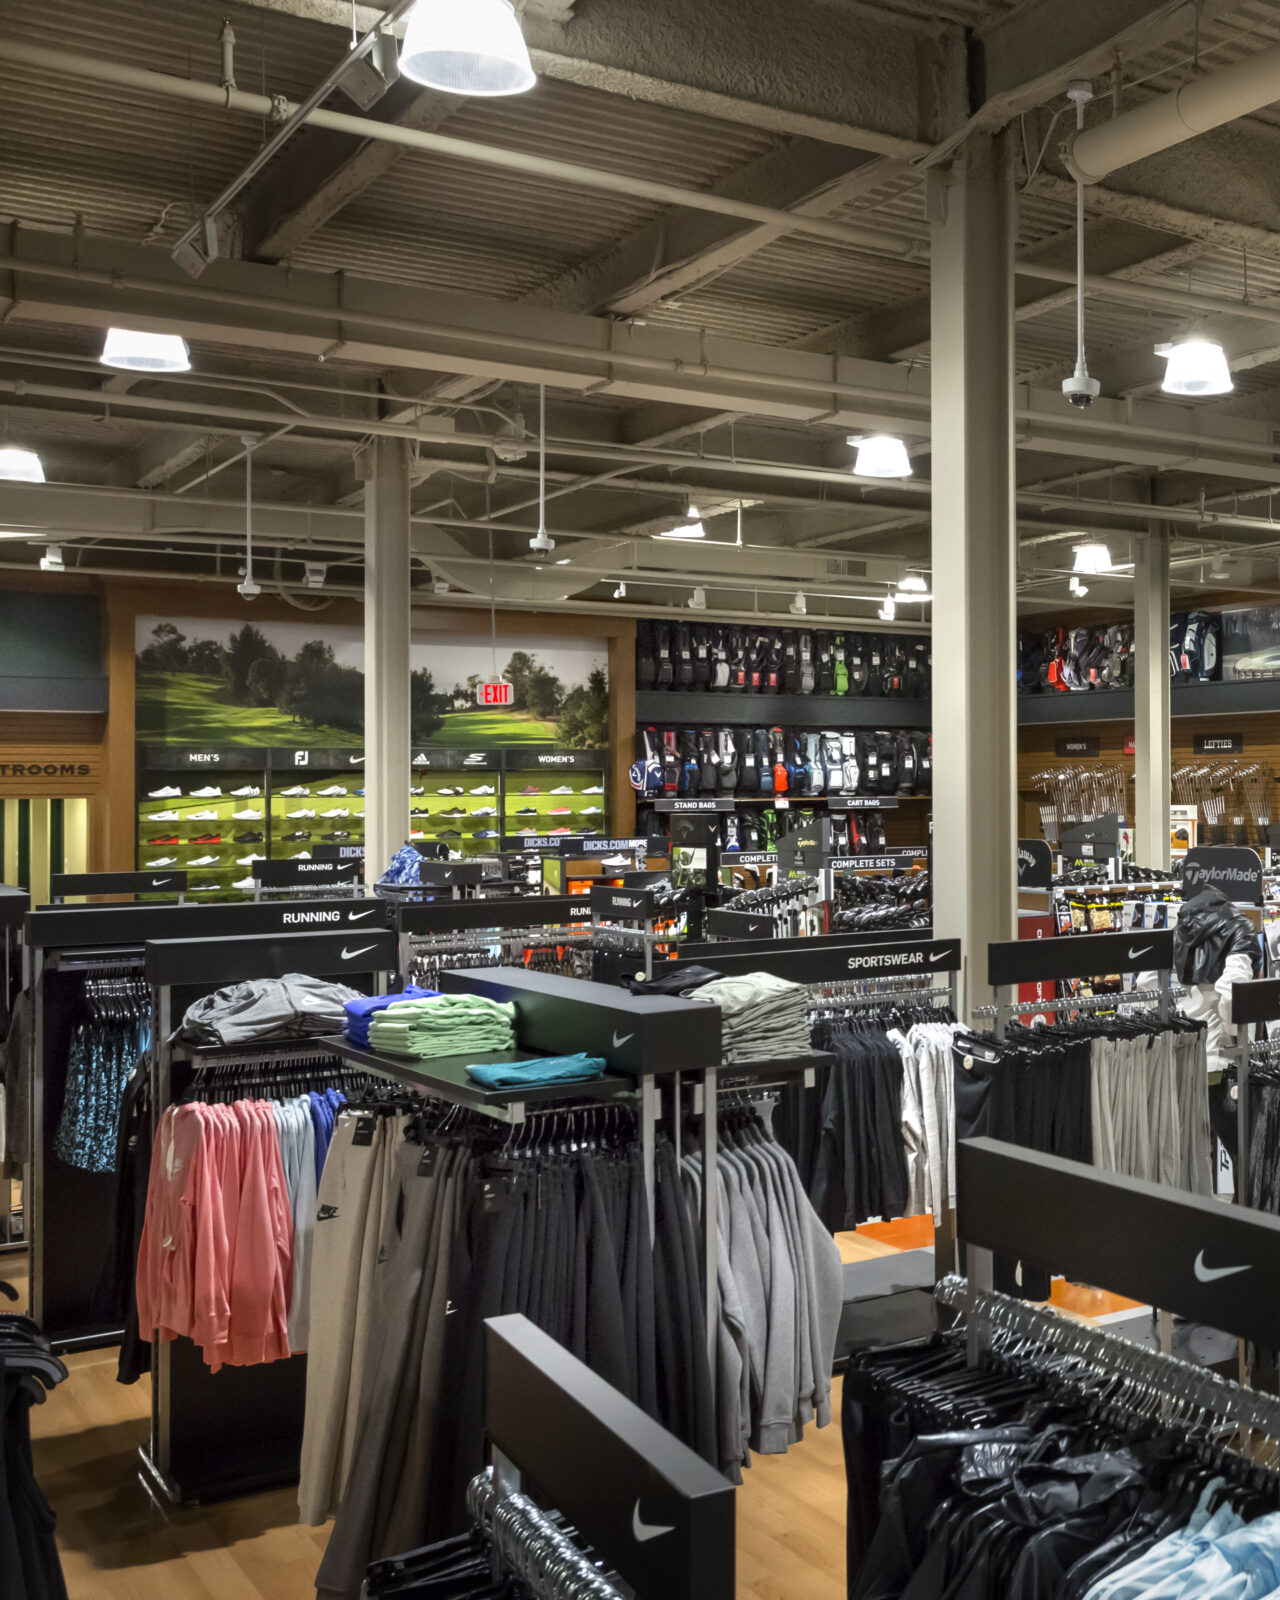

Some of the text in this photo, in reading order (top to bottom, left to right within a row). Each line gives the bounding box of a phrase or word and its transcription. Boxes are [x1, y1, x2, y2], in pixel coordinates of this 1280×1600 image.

[484, 684, 509, 703] EXIT
[1204, 740, 1232, 748] LEFTIES
[189, 754, 220, 762] MEN'S
[538, 755, 575, 763] WOMEN'S
[0, 764, 90, 776] TROOMS
[524, 837, 560, 847] DICKS.CO
[583, 840, 629, 850] DICKS.COM
[298, 864, 333, 872] RUNNING
[831, 858, 896, 868] COMPLETE SETS
[1186, 862, 1257, 884] TaylorMade
[283, 910, 340, 925] RUNNING
[848, 953, 923, 969] SPORTSWEAR
